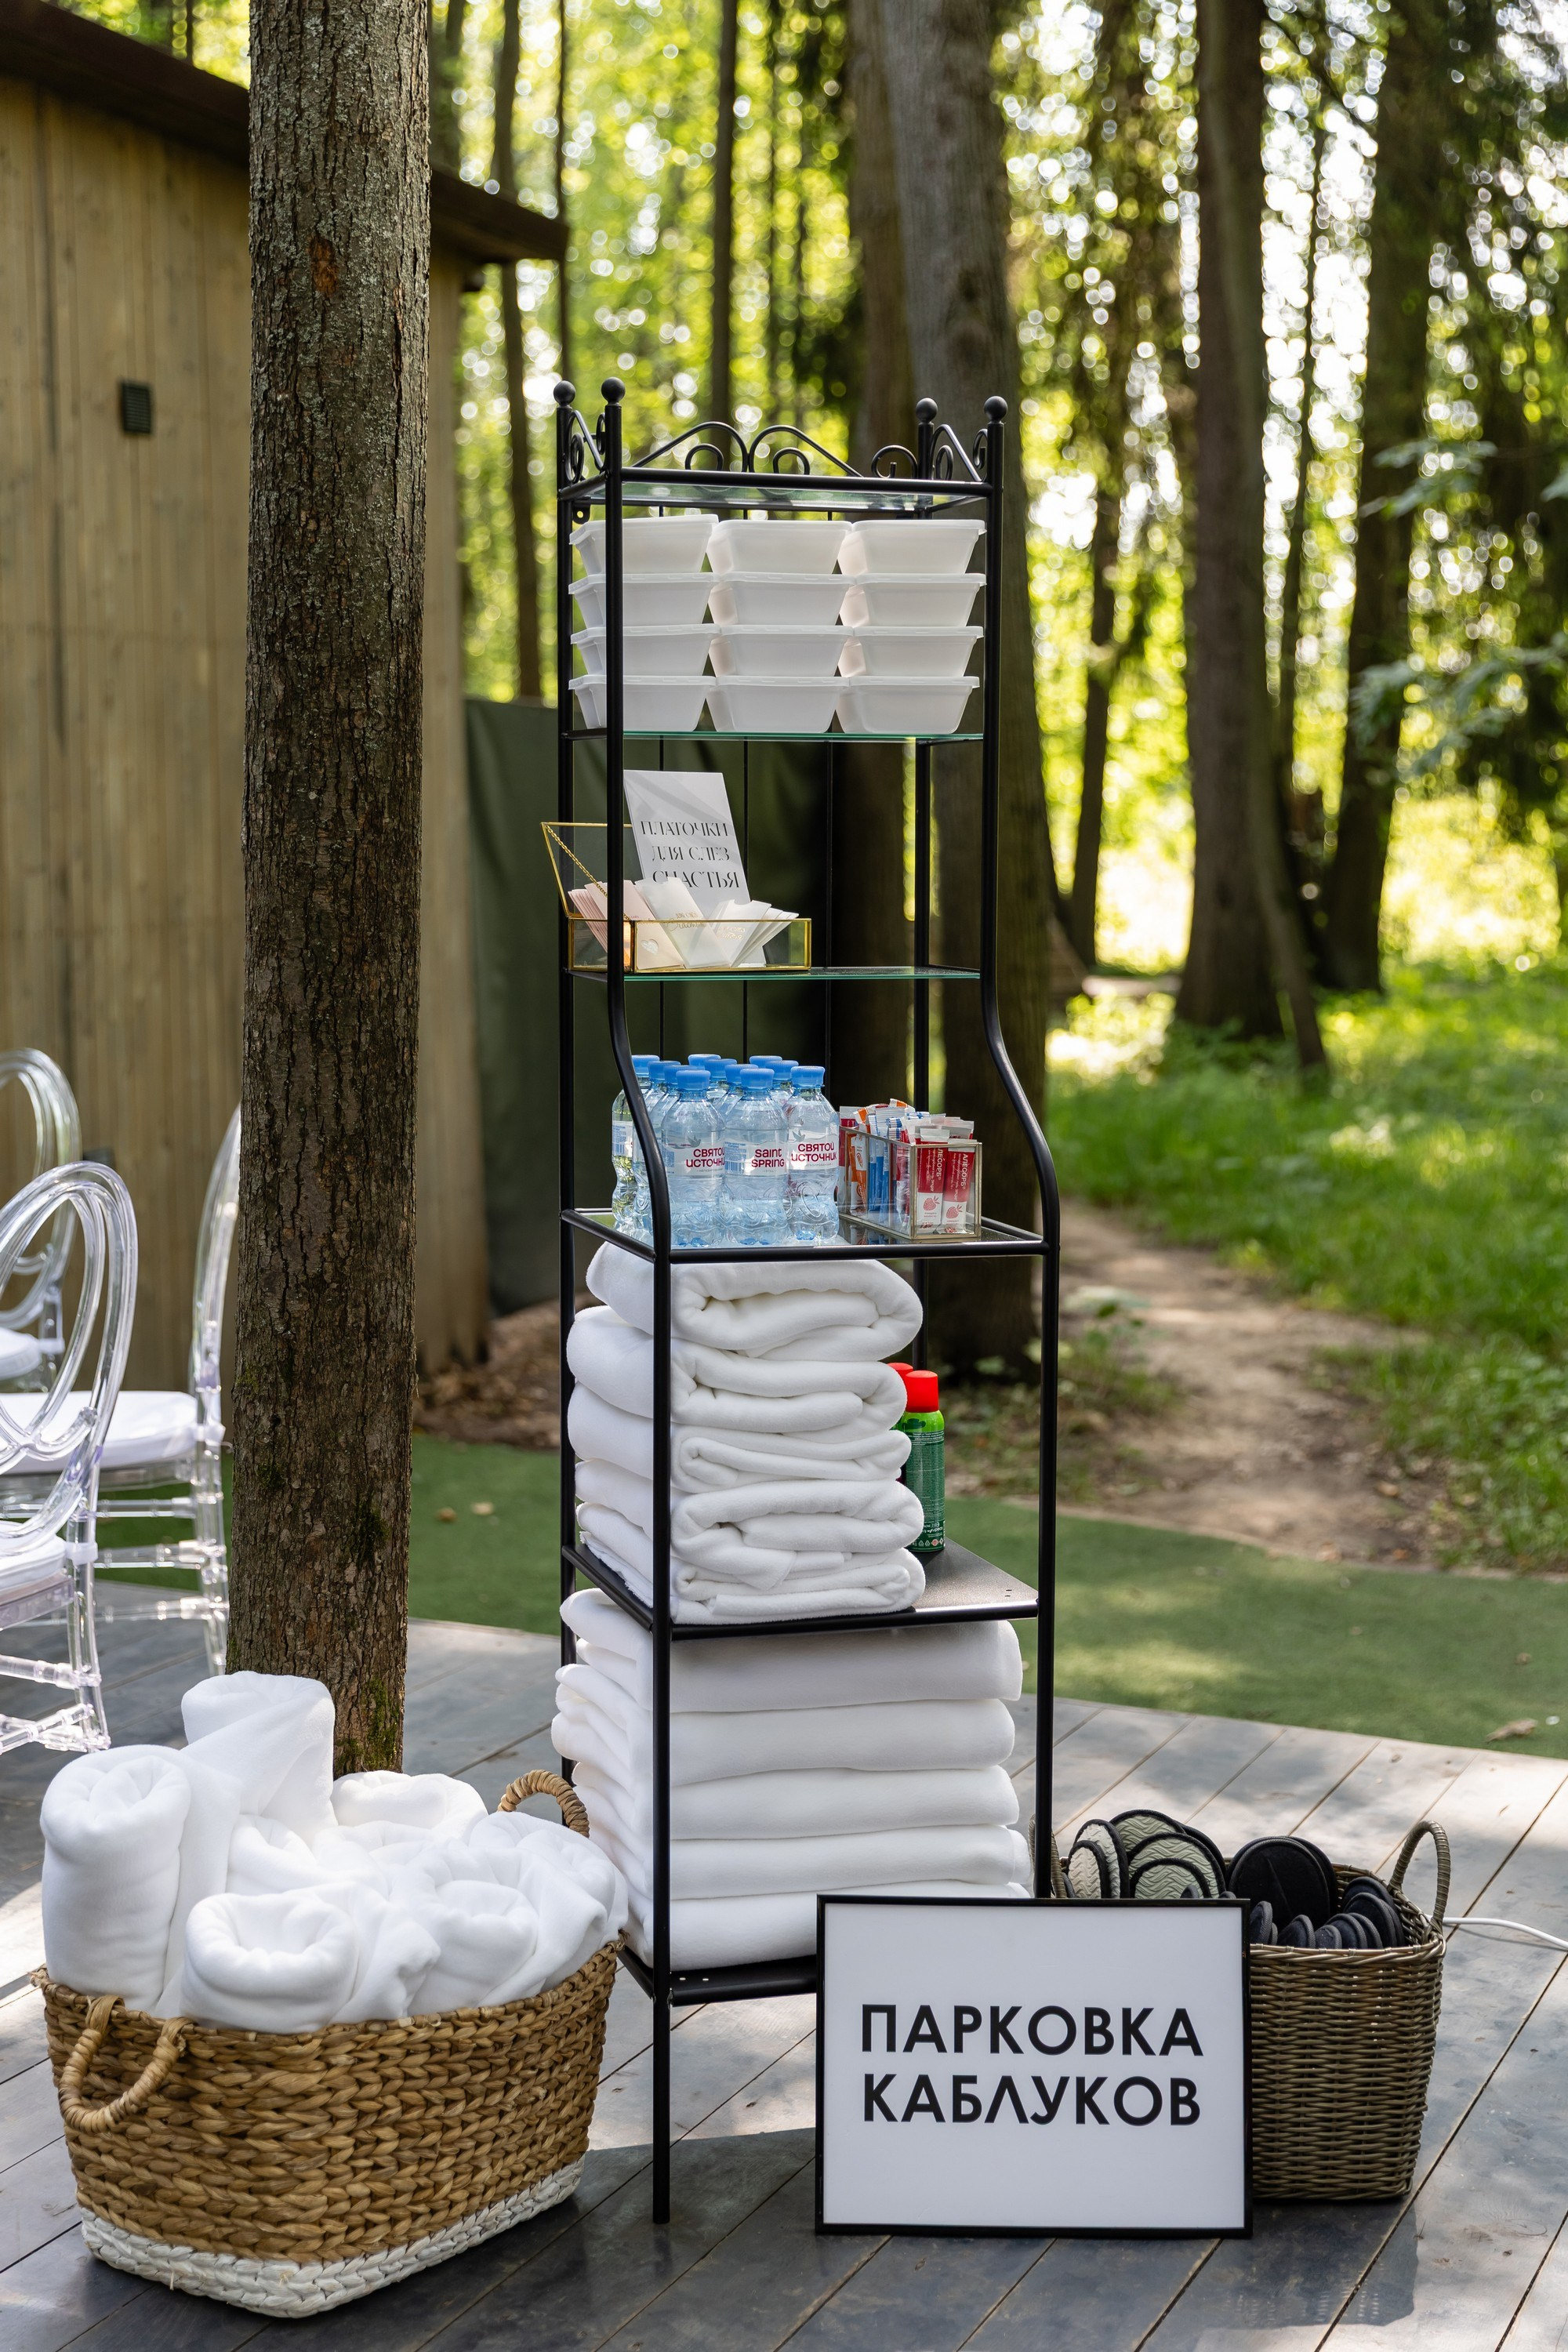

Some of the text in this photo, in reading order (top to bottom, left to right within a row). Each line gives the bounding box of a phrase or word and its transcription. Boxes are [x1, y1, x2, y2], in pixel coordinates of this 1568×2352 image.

[641, 821, 728, 837] ПЛАТОЧКИ
[652, 846, 730, 862] ДЛЯ СЛЕЗ
[862, 2004, 1204, 2057] ПАРКОВКА
[864, 2074, 1201, 2126] КАБЛУКОВ
